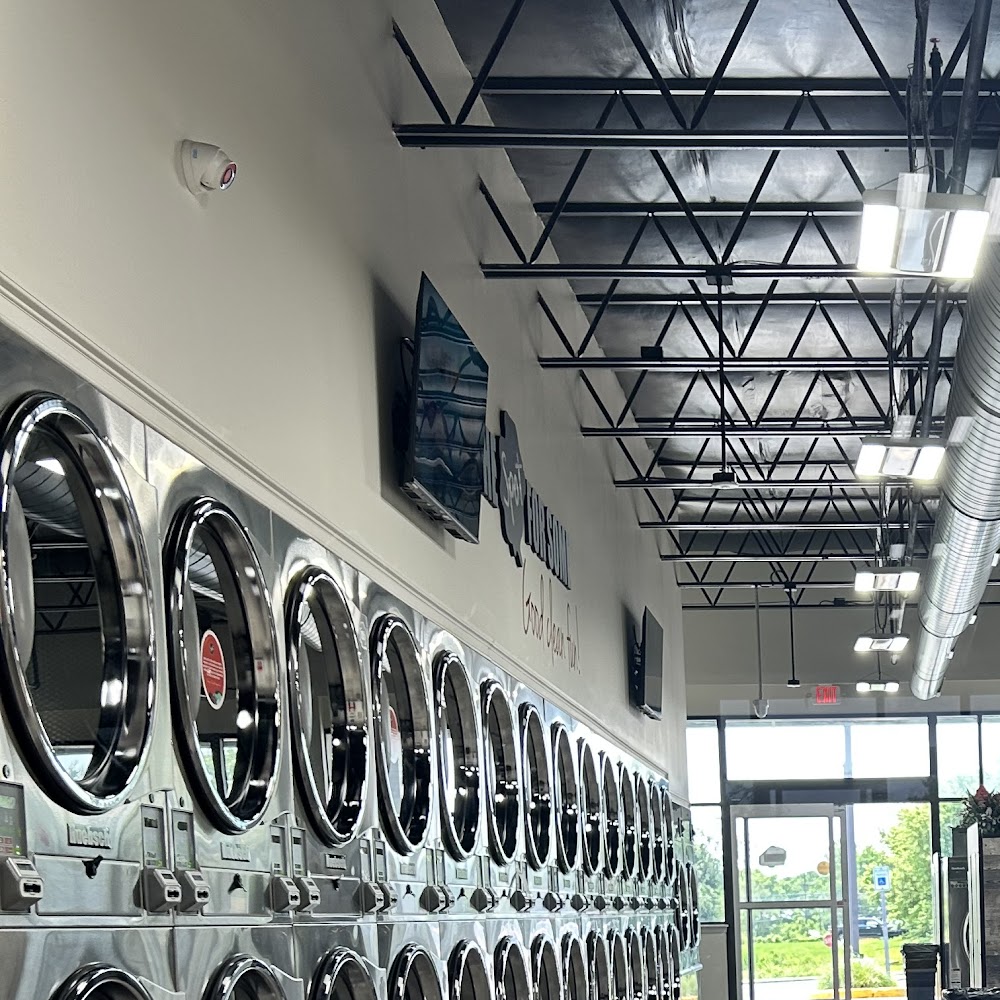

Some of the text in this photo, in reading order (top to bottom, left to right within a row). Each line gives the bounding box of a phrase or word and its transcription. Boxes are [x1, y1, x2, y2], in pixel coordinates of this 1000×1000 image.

[501, 451, 523, 526] Spot
[524, 479, 547, 562] FOR
[816, 685, 837, 704] EXIT
